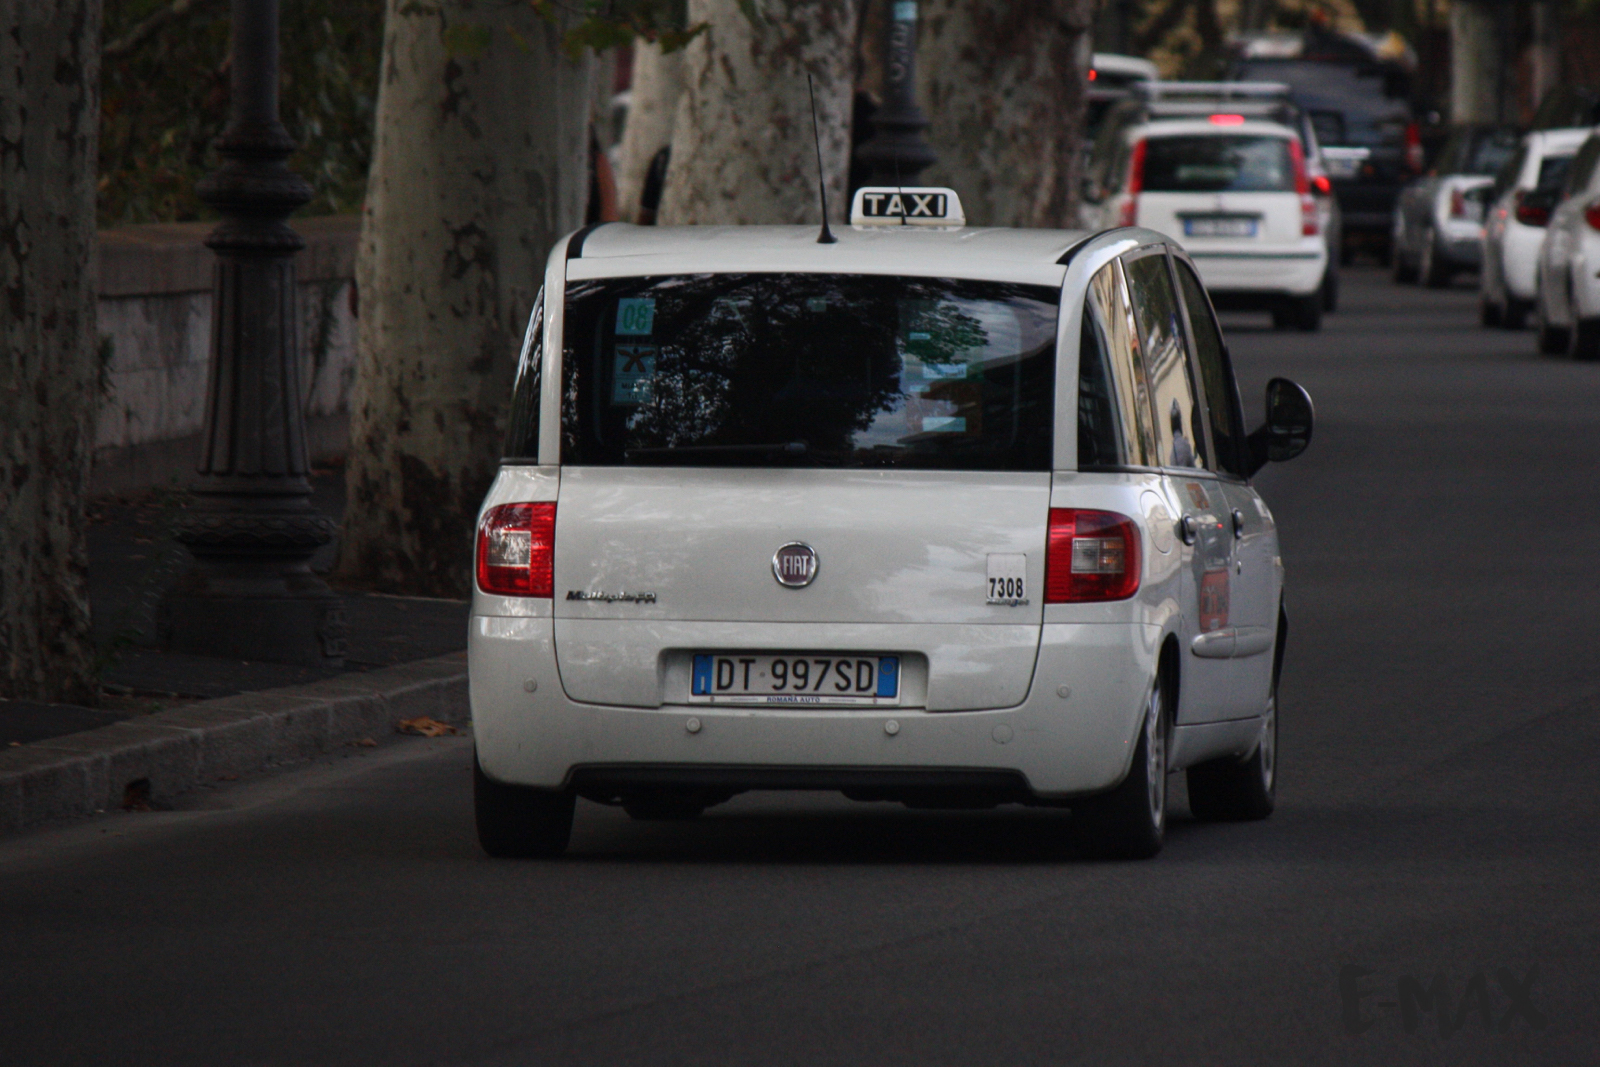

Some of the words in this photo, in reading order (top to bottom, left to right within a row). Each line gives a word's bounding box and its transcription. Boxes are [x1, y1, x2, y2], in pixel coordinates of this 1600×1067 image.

[864, 193, 945, 216] TAXI
[783, 555, 809, 576] FIAT
[989, 577, 1024, 598] 7308
[716, 658, 756, 691] DT
[771, 659, 874, 692] 997SD
